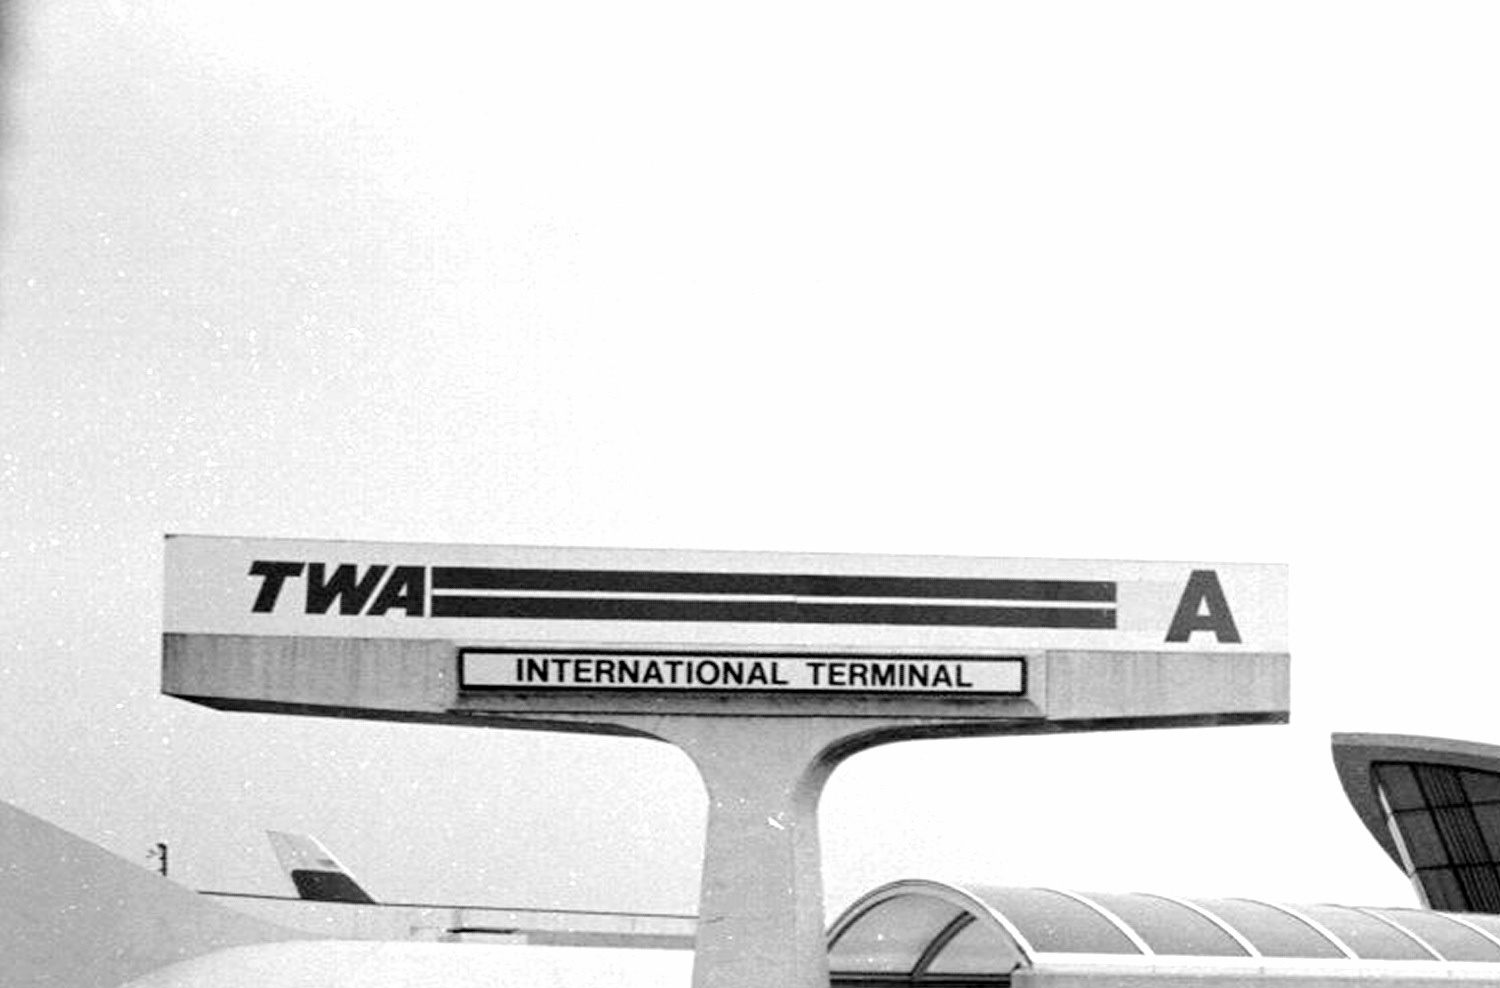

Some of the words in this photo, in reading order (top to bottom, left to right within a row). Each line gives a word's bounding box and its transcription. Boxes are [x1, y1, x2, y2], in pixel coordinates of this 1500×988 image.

[248, 561, 426, 617] TWA
[1164, 569, 1241, 644] A
[516, 658, 788, 686] INTERNATIONAL
[806, 662, 973, 688] TERMINAL
